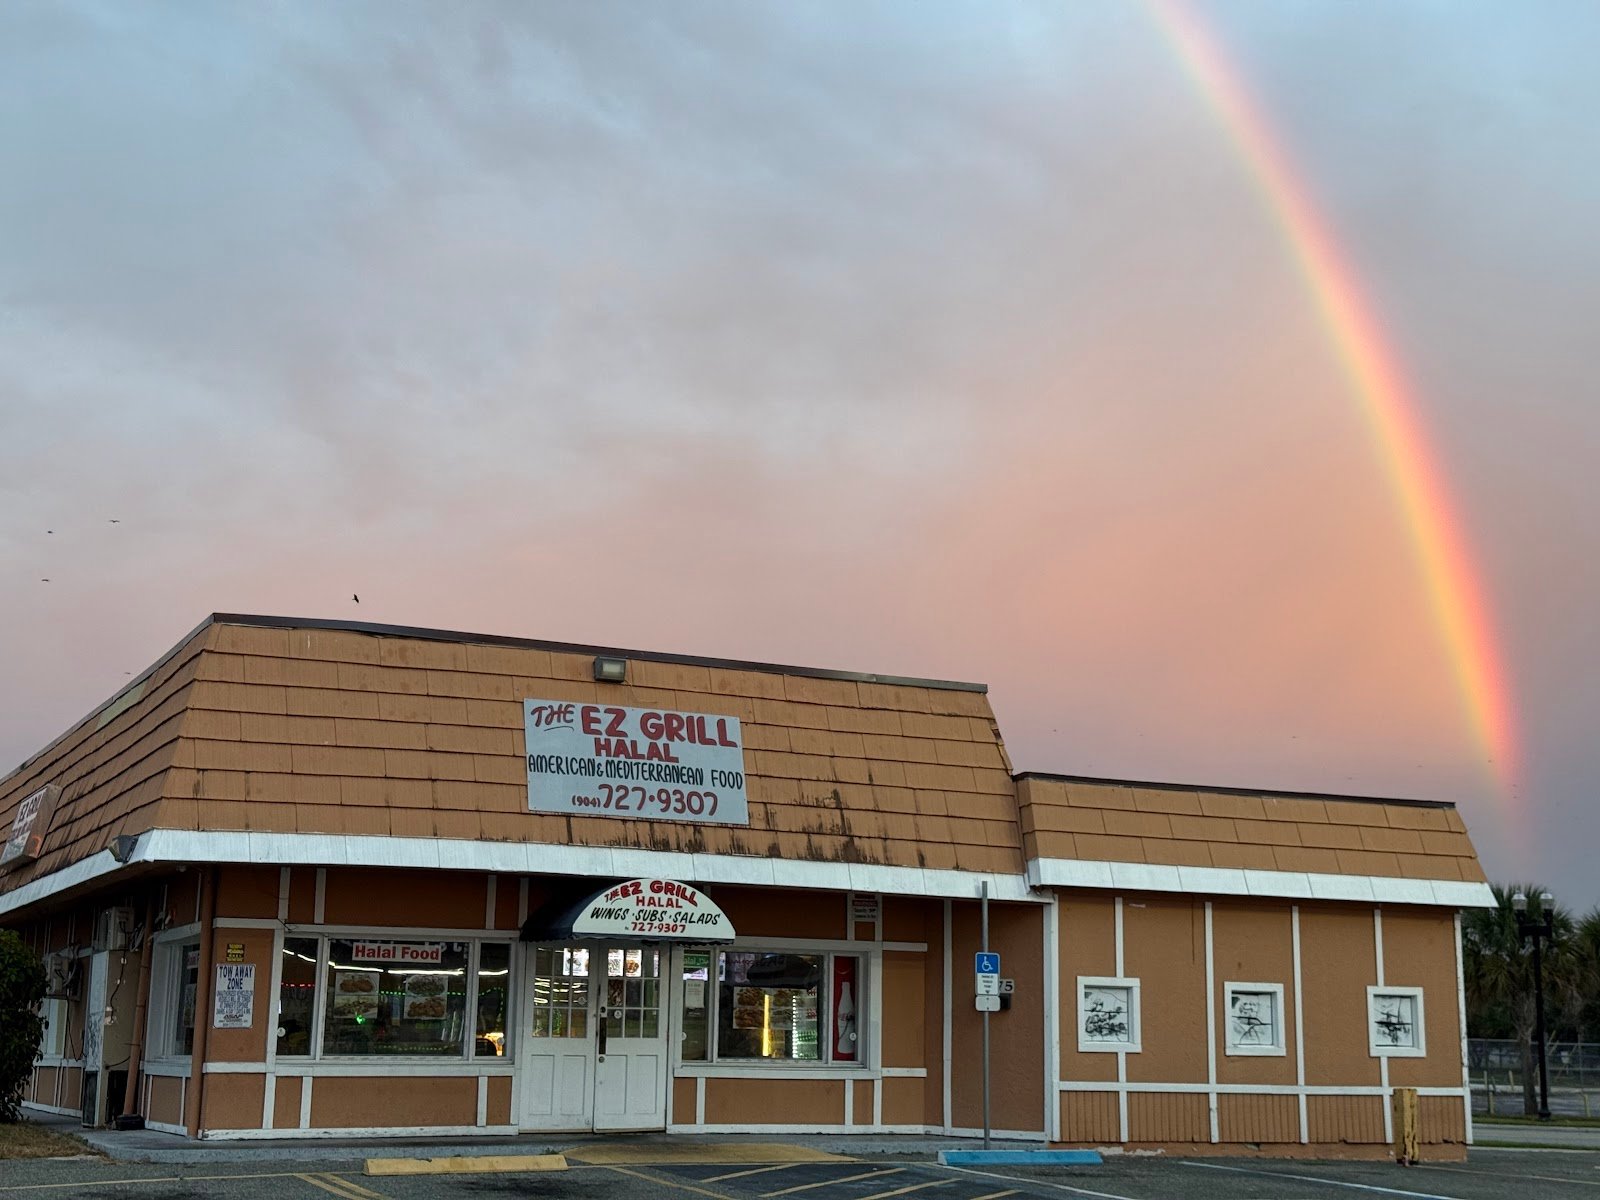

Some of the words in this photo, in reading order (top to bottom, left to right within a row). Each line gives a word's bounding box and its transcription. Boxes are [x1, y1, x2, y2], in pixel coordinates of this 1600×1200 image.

[531, 704, 575, 727] THE
[581, 706, 628, 738] EZ
[640, 712, 738, 748] GRILL
[594, 738, 679, 763] HALAL
[528, 754, 596, 777] AMERICAN
[605, 759, 704, 786] MEDITERRANEAN
[711, 769, 743, 790] FOOD
[572, 795, 601, 808] (904)
[604, 888, 620, 903] THE
[620, 881, 643, 898] EZ
[649, 880, 698, 907] GRILL
[636, 896, 683, 909] HALAL
[590, 907, 630, 921] WINGS
[635, 910, 668, 922] SUBS
[673, 911, 720, 925] SALADS
[355, 944, 396, 959] Halal
[401, 946, 439, 960] Food
[220, 966, 233, 978] TOW
[235, 966, 253, 978] AWAY
[227, 978, 243, 989] ZONE
